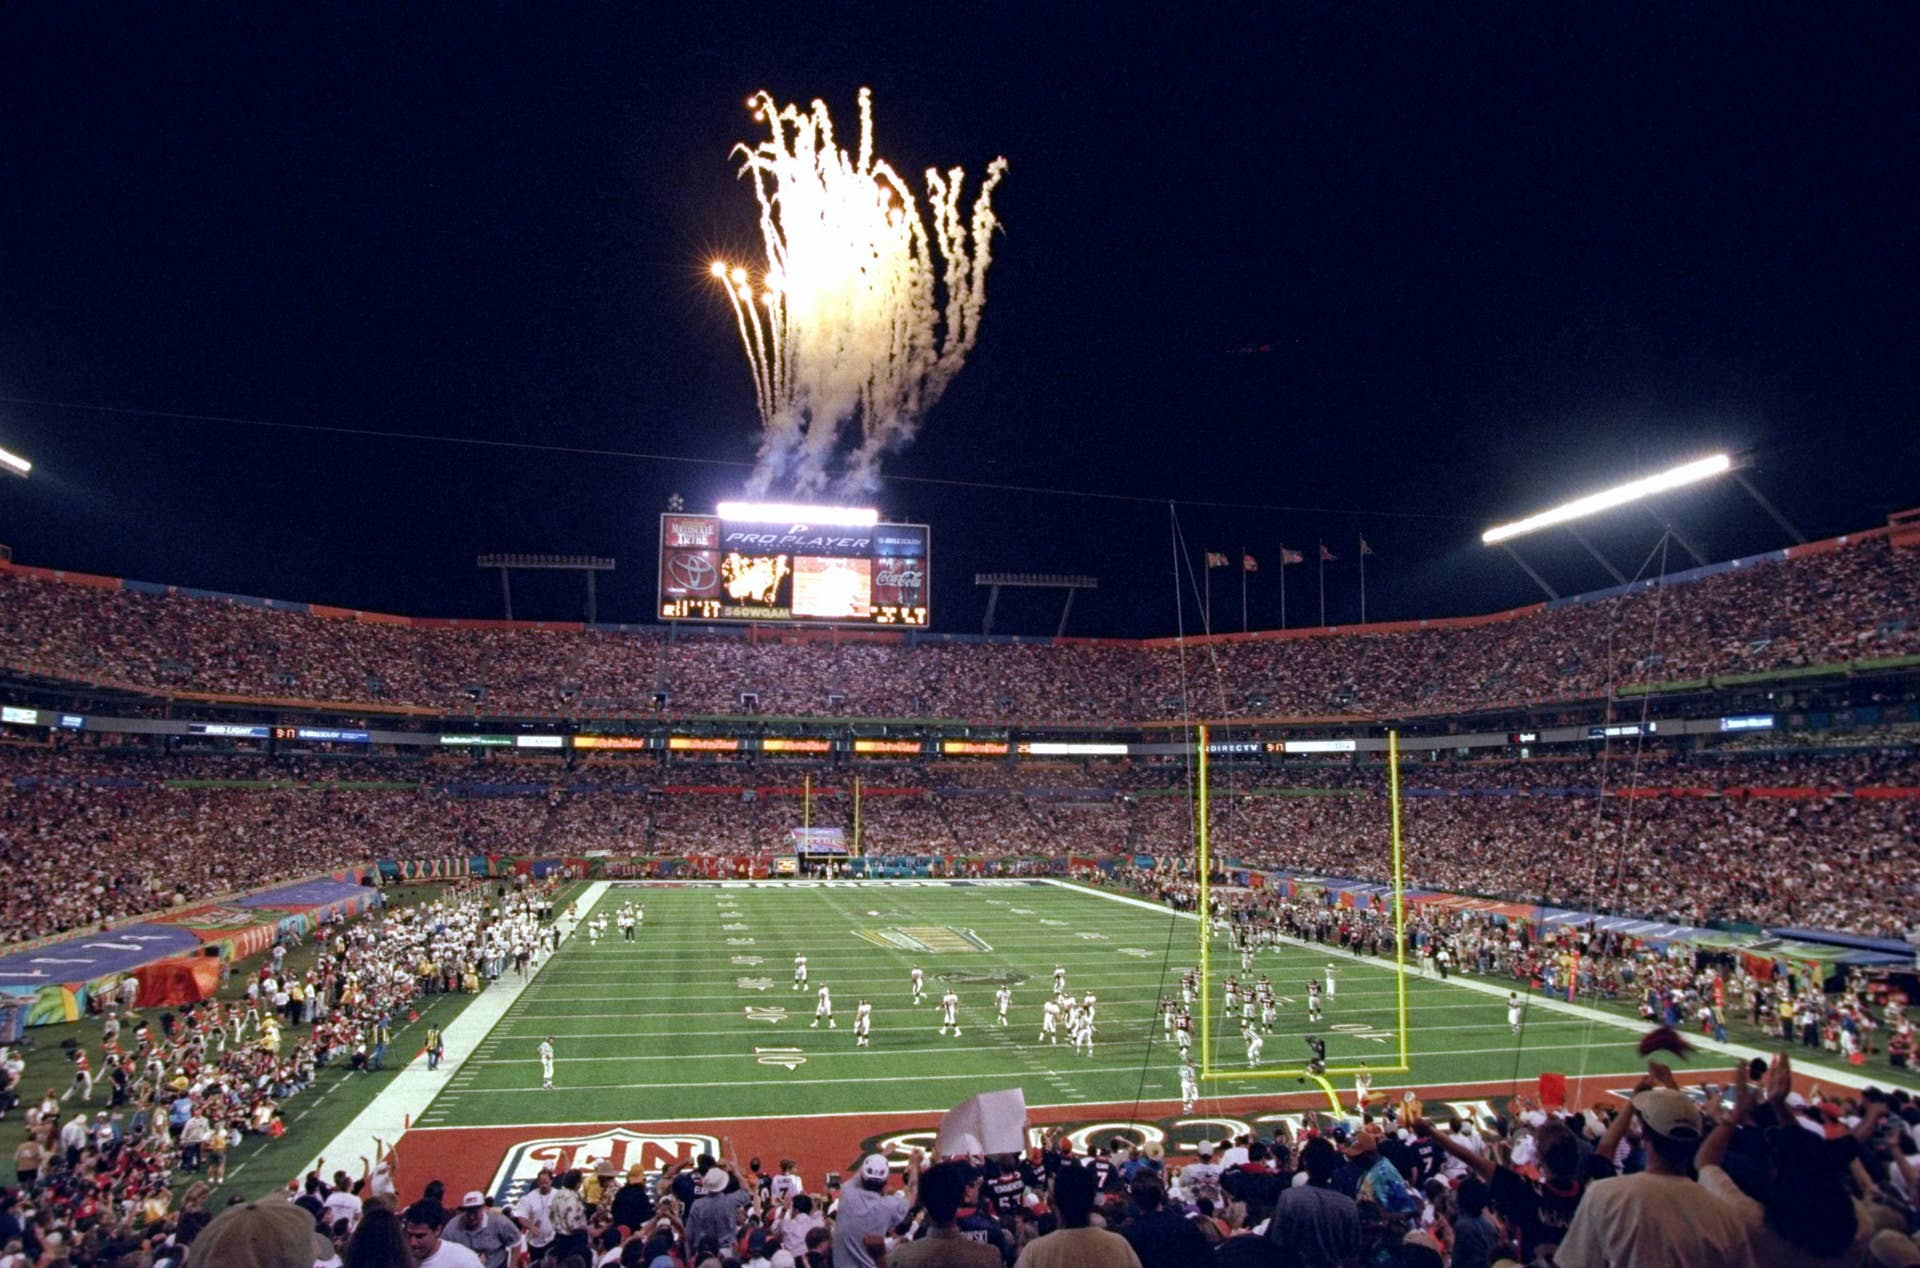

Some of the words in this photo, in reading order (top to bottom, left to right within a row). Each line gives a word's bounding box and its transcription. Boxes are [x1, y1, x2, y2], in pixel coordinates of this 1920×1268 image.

[726, 532, 777, 543] PRO
[779, 535, 870, 548] PLAYER
[1211, 743, 1258, 752] DIRECTV
[397, 858, 470, 879] XXXIII
[754, 1046, 808, 1065] 10
[1422, 1157, 1433, 1174] 7
[1097, 1172, 1107, 1188] 7
